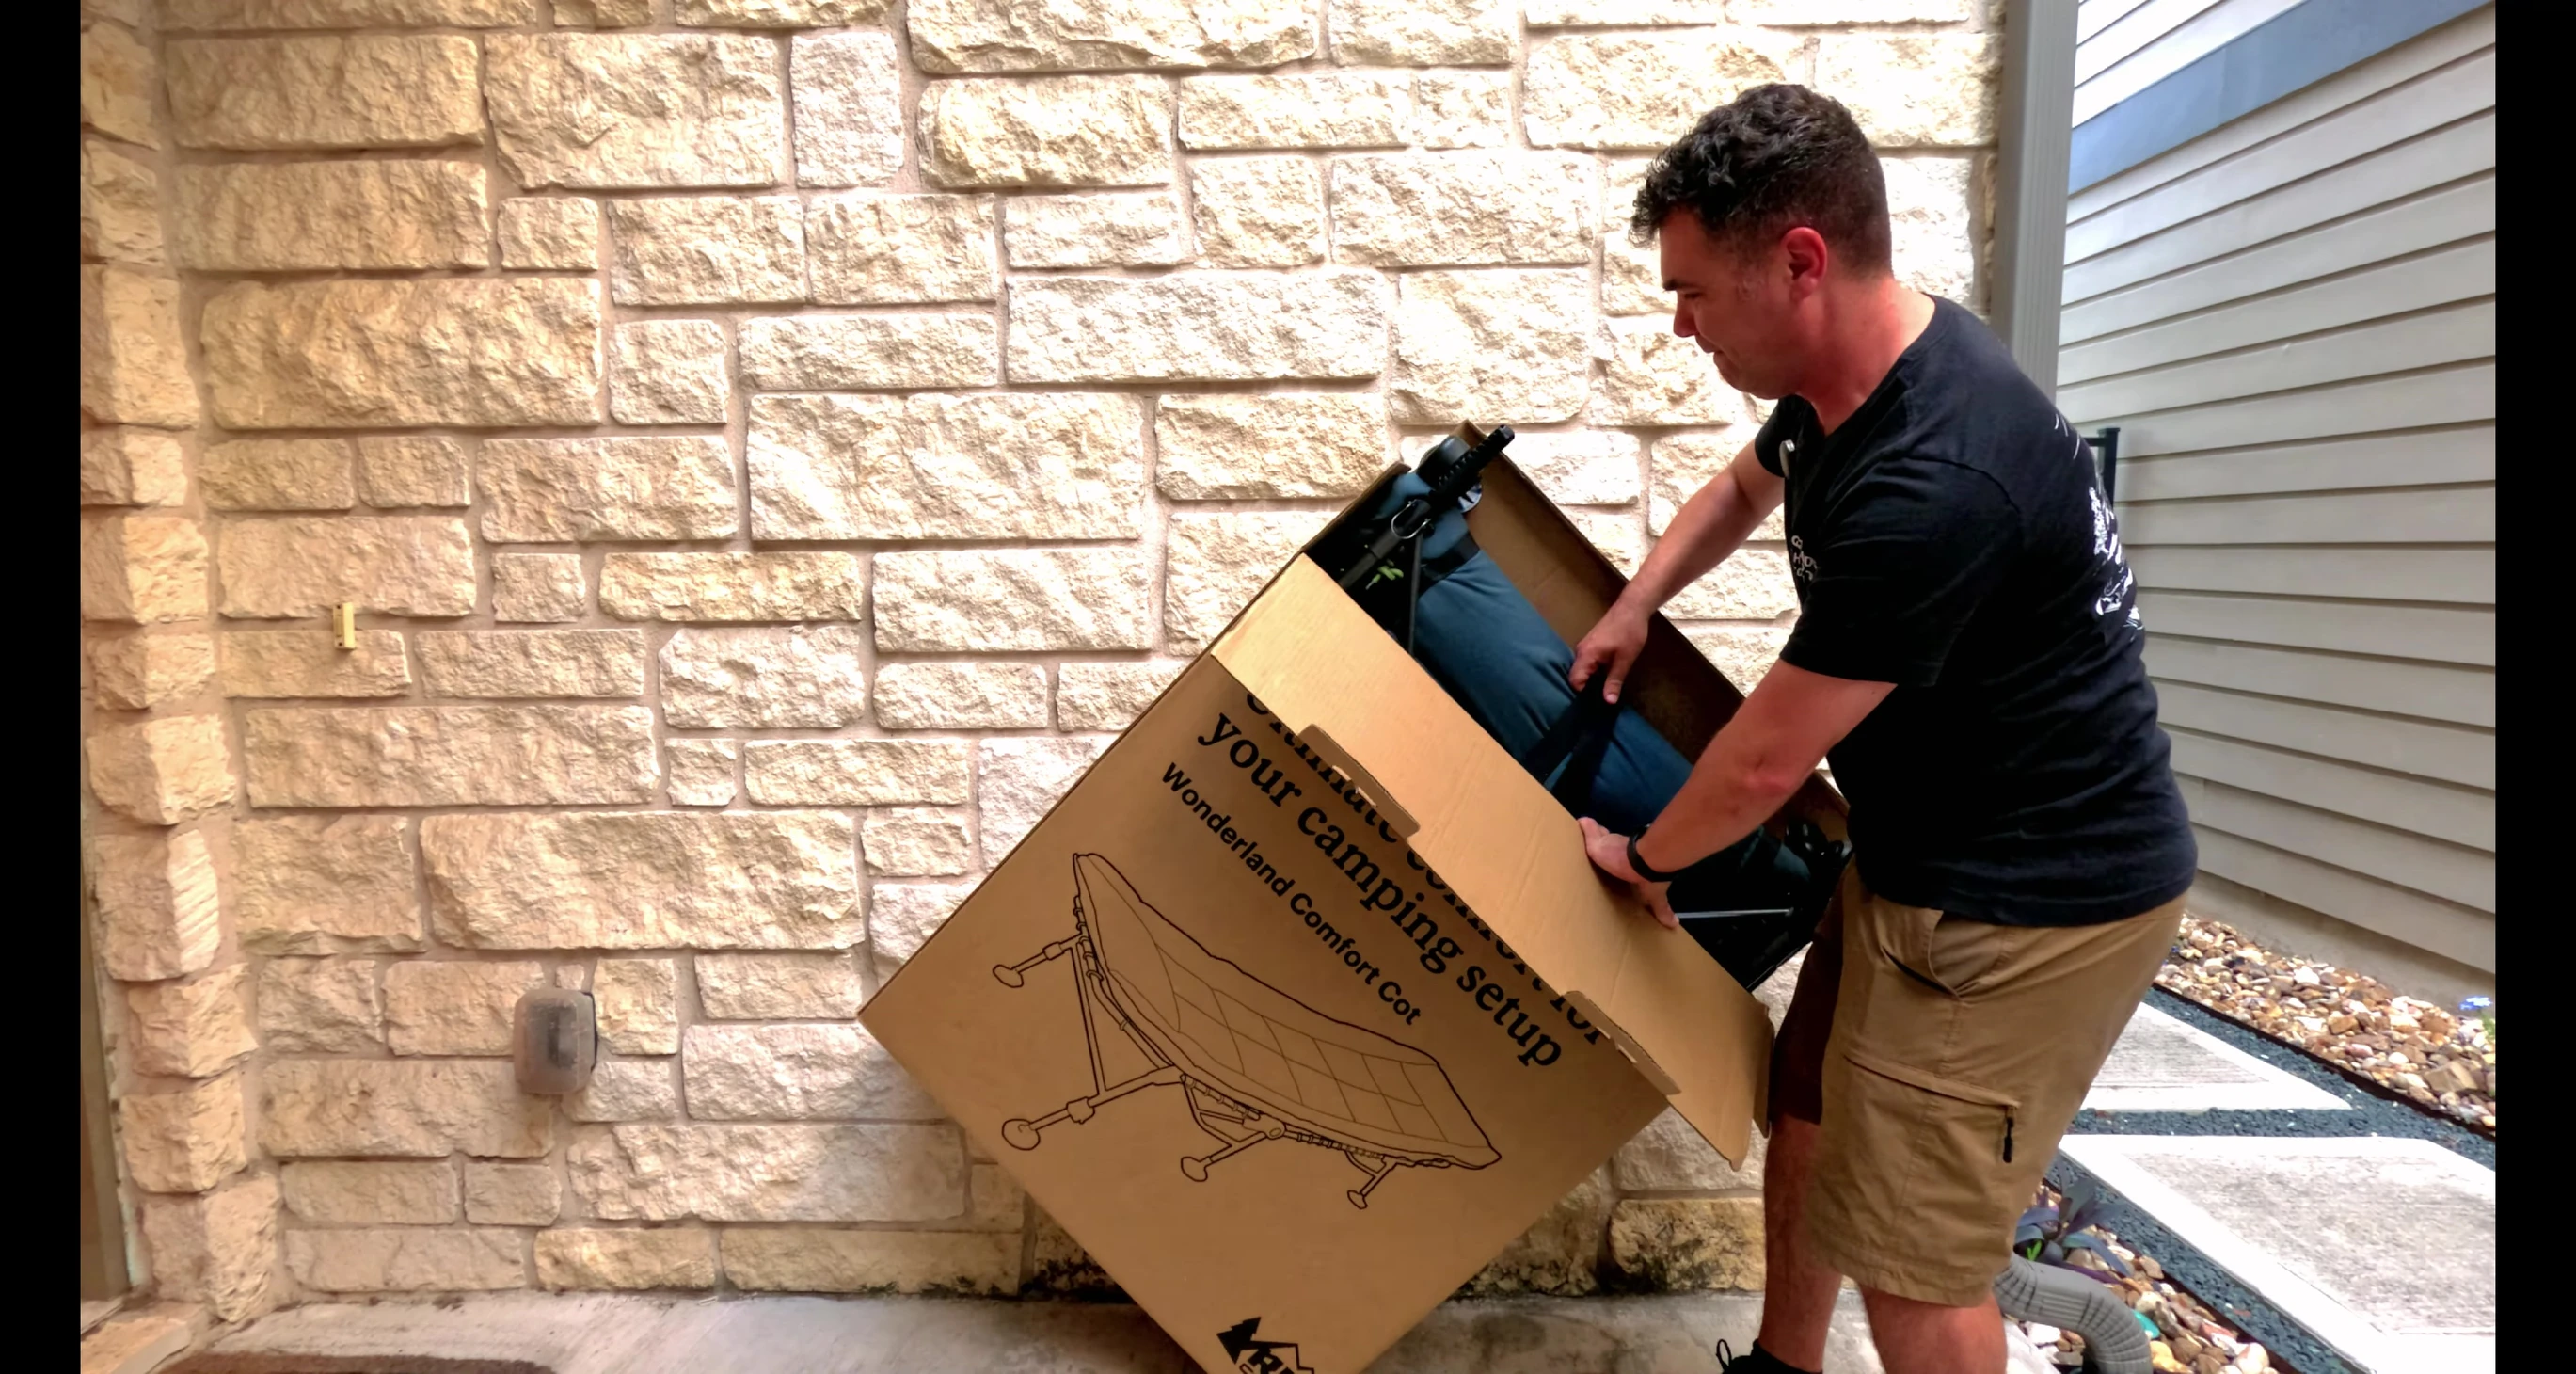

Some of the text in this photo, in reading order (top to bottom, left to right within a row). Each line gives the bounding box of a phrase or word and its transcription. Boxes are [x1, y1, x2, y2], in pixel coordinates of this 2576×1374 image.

[1162, 761, 1296, 898] Wonderland
[1289, 892, 1381, 986] Comfort
[1377, 980, 1422, 1026] Cot
[1197, 712, 1303, 807] your
[1296, 807, 1466, 975] camping
[1456, 965, 1563, 1067] setup
